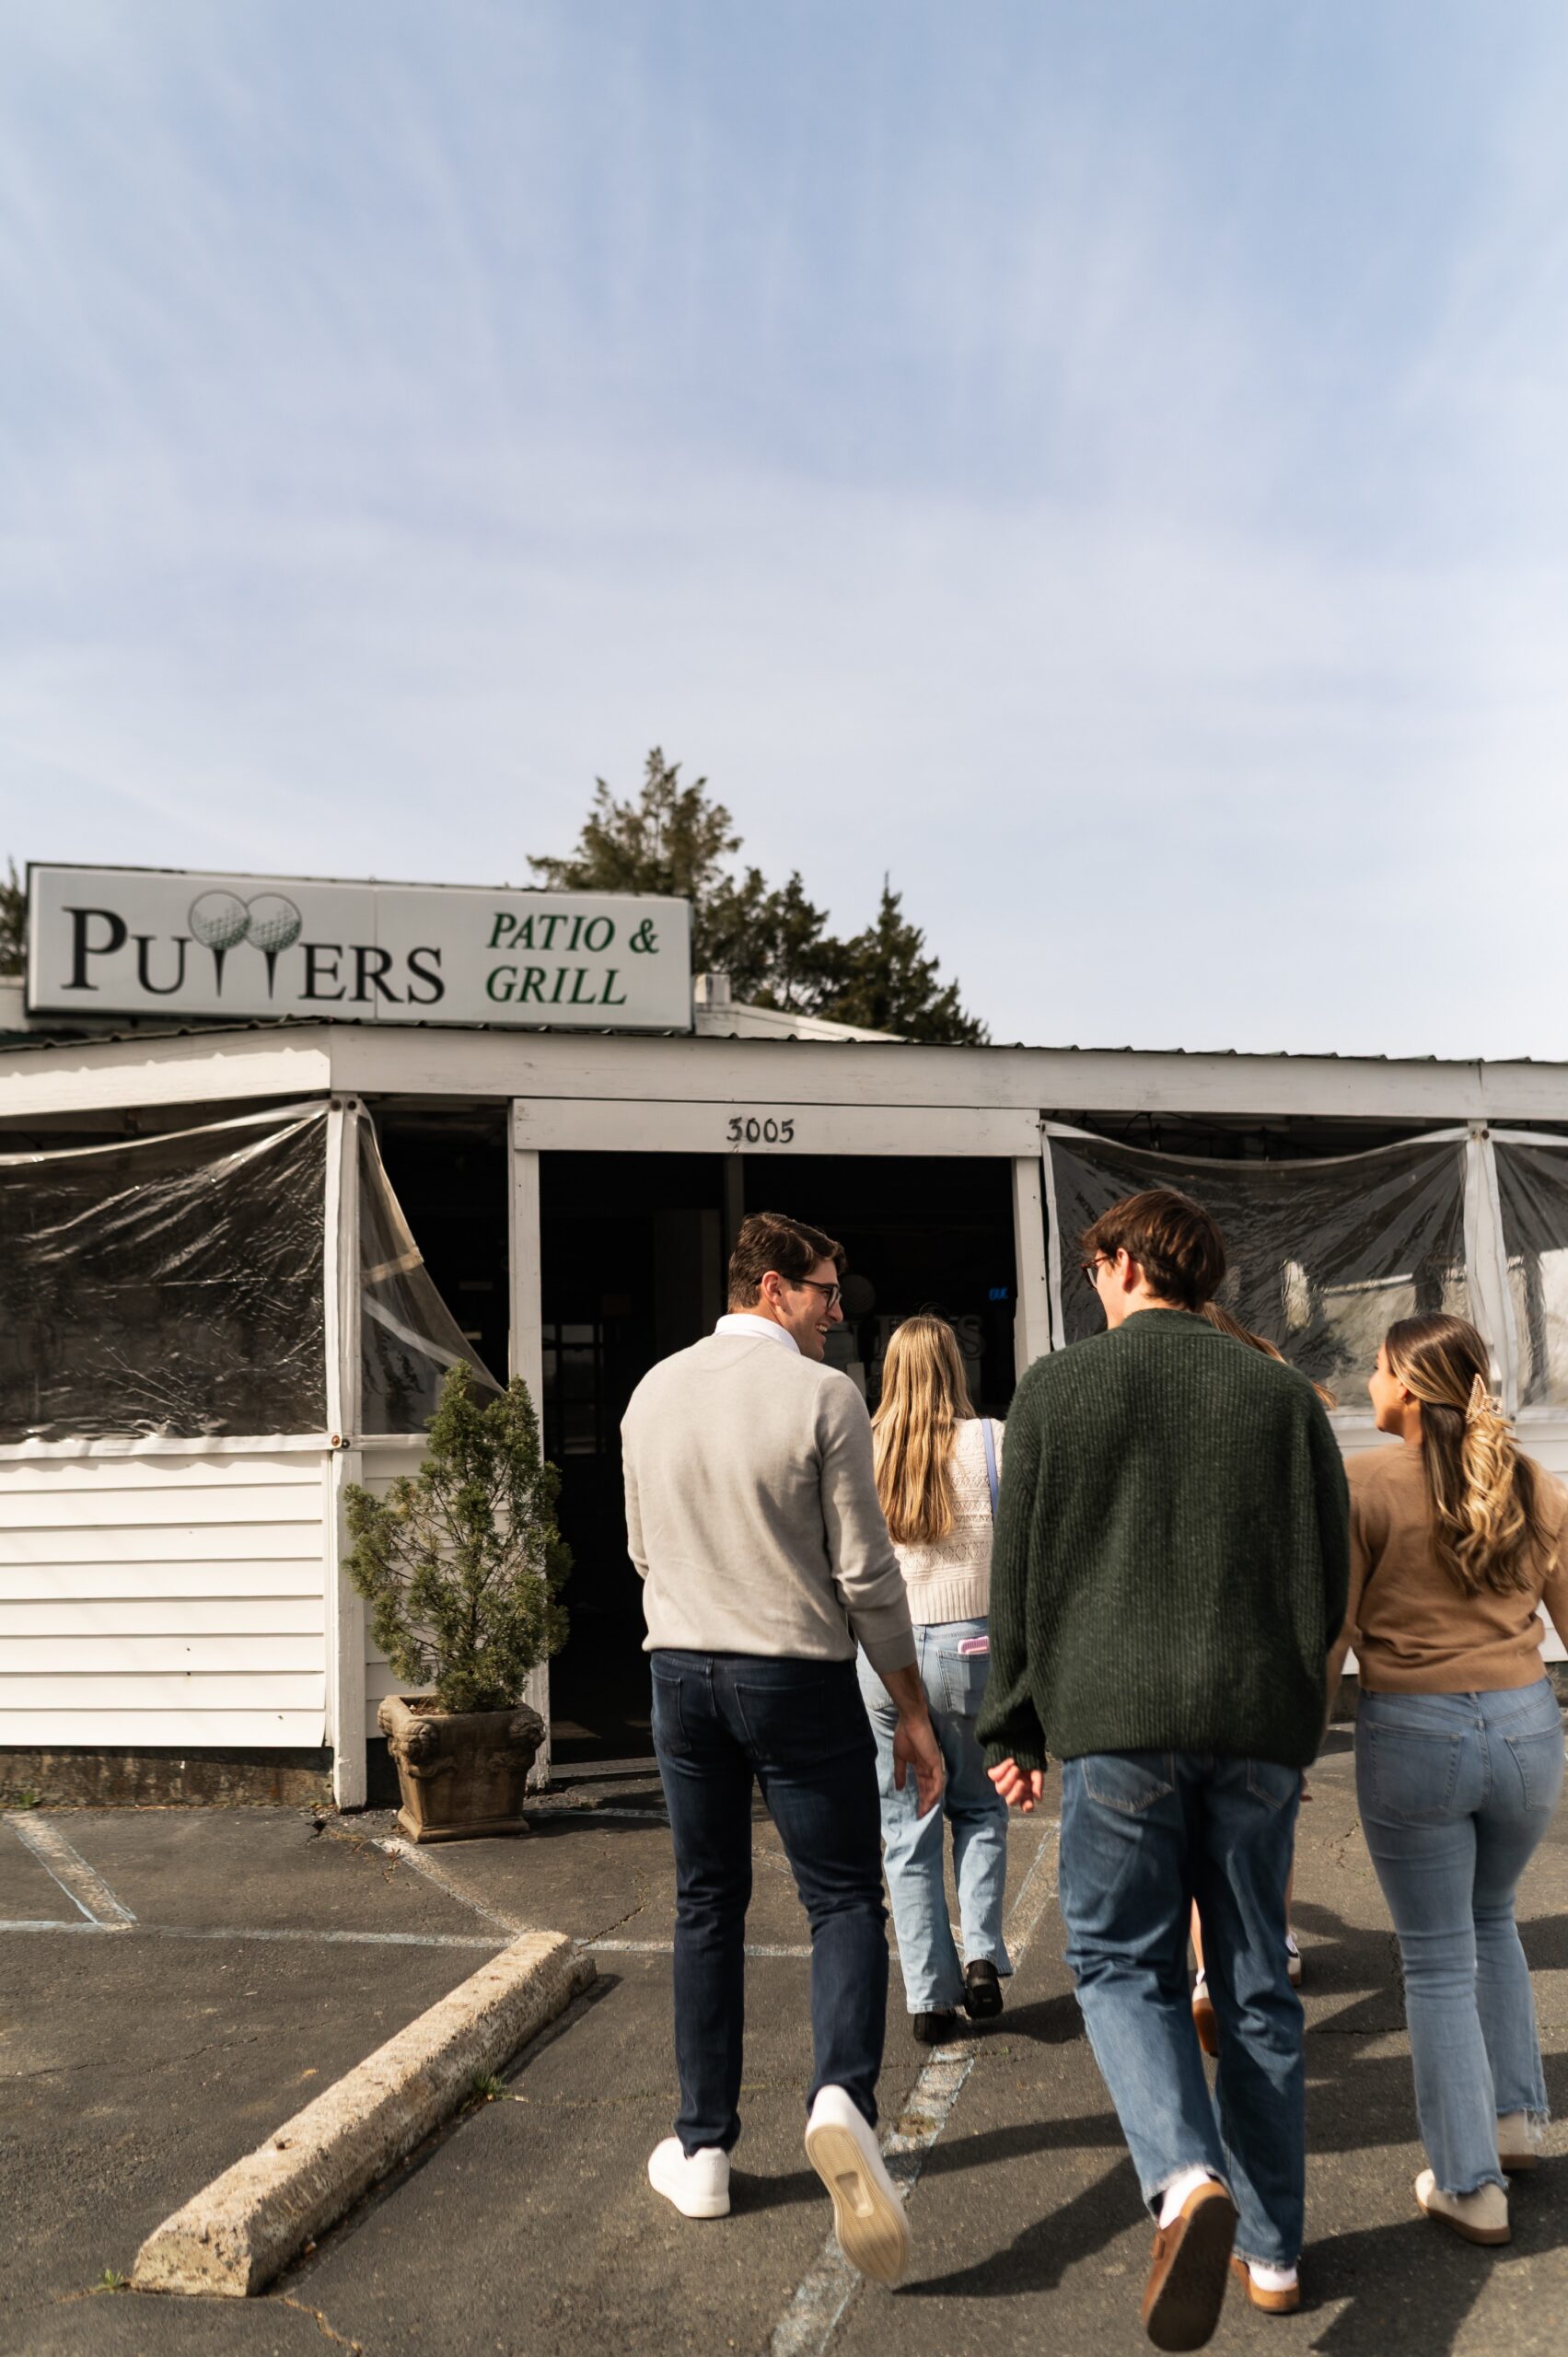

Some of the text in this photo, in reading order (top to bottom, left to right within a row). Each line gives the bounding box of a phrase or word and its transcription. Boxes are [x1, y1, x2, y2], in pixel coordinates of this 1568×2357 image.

[486, 911, 660, 954] PATIO &
[485, 965, 628, 1005] GRILL
[726, 1116, 795, 1144] 3005
